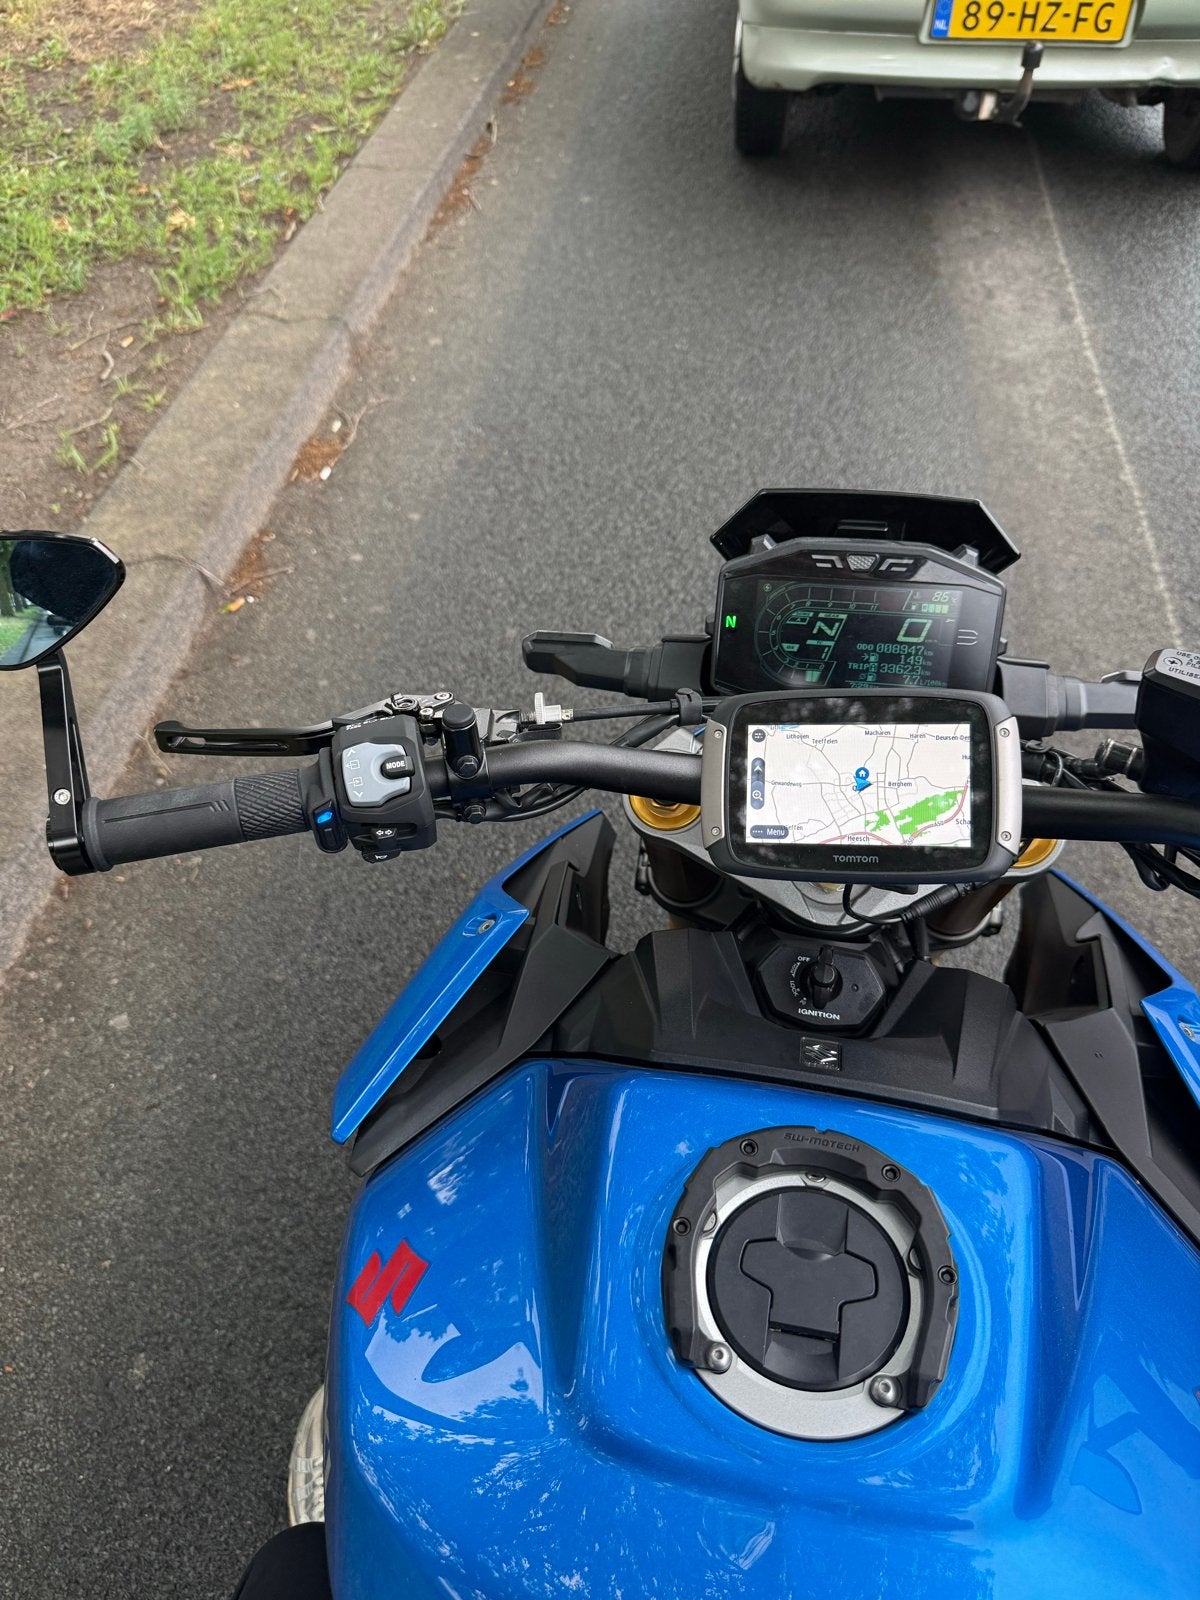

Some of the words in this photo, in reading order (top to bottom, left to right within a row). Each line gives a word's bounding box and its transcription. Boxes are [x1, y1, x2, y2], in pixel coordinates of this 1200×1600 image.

[962, 1, 1115, 33] 89-HZ-FG
[725, 615, 737, 629] N
[812, 621, 841, 637] N
[896, 618, 933, 643] 0
[856, 643, 874, 651] ODO
[876, 642, 925, 655] 008947
[848, 662, 869, 670] TRIP
[899, 654, 924, 666] 149
[385, 760, 406, 770] MODE
[887, 781, 913, 789] Berghem
[766, 827, 786, 836] Menu
[847, 834, 870, 843] Heesch
[798, 1007, 841, 1021] IGNITION
